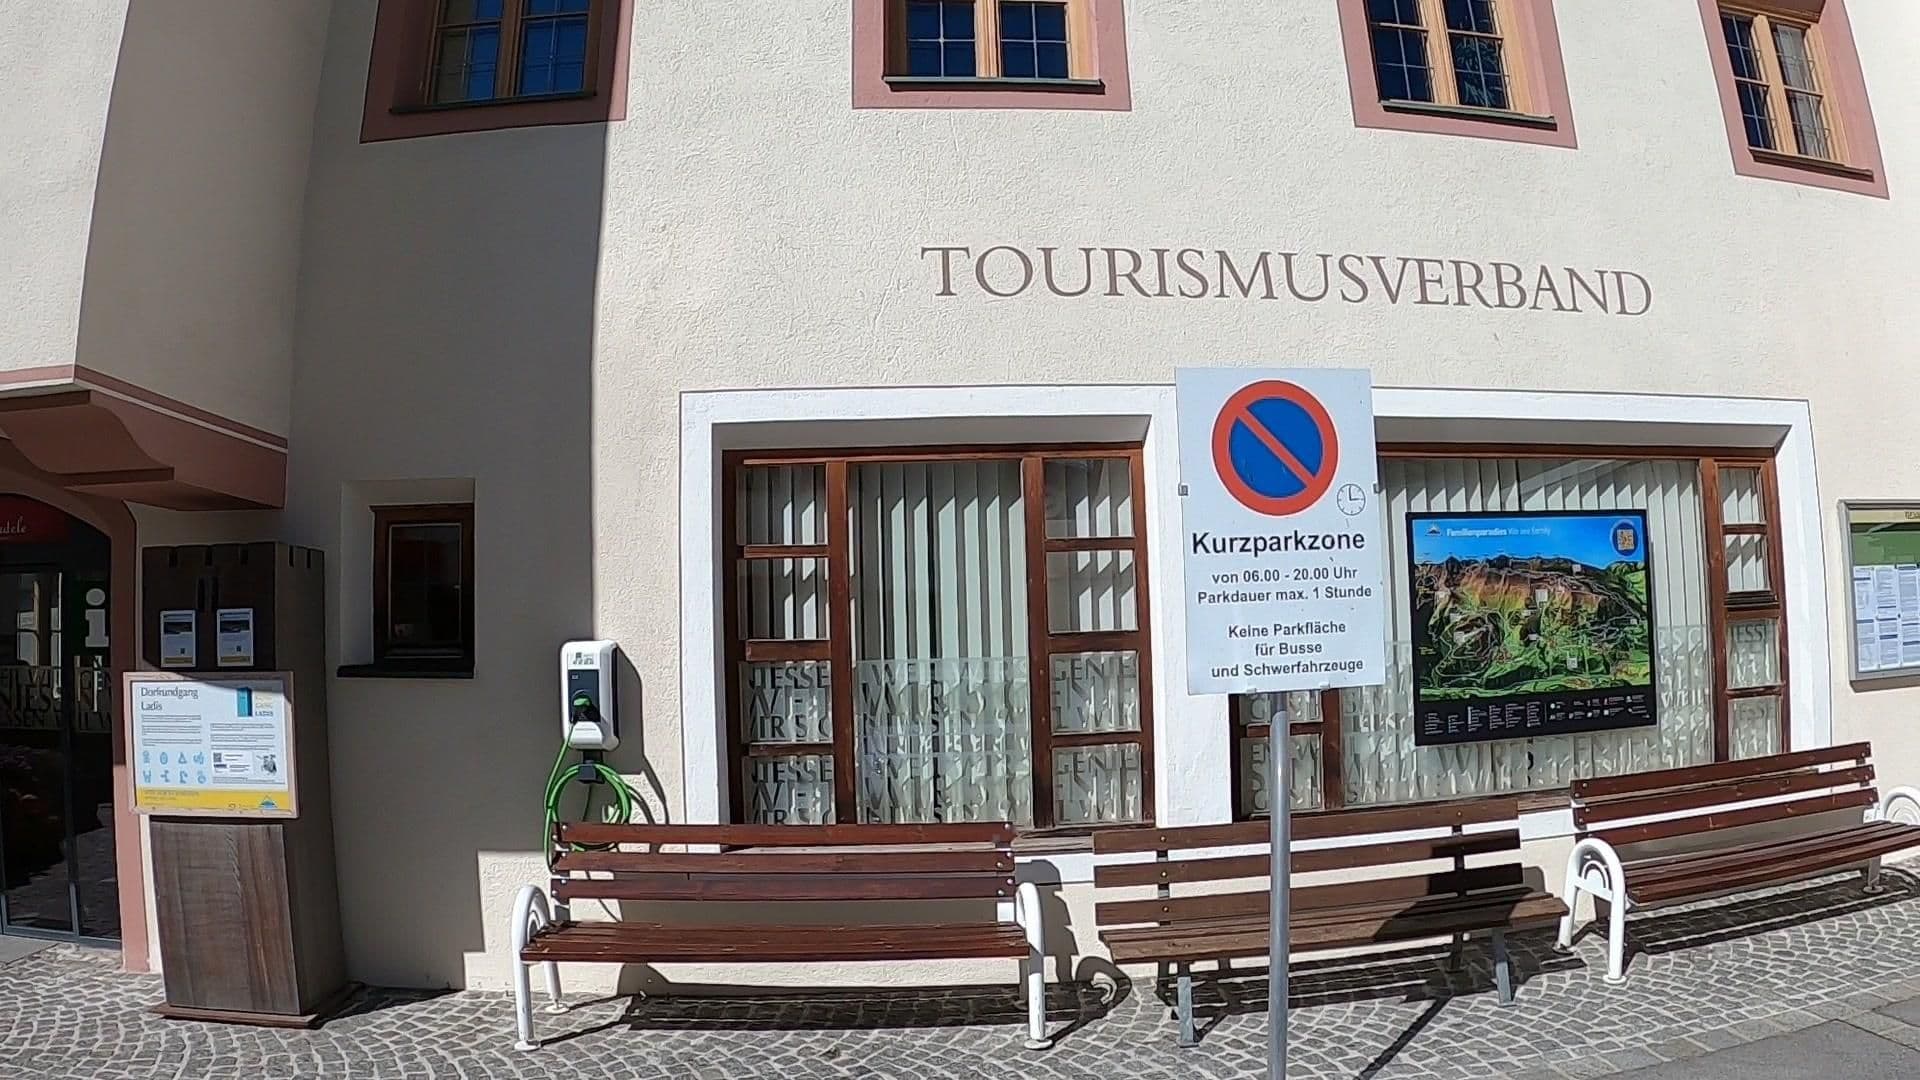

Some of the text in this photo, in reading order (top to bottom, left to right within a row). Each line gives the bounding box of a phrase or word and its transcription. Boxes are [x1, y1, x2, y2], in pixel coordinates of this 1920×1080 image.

[921, 246, 1652, 316] TOURISMUSVERBAND
[1192, 530, 1366, 557] Kurzparkzone
[1211, 574, 1239, 584] von
[1243, 569, 1280, 583] 06.00
[1293, 567, 1329, 581] 20.00
[1333, 566, 1358, 579] Uhr
[1198, 585, 1372, 604] Parkdauer max. 1 Stunde
[1228, 621, 1346, 638] Keine Parkfläche
[1255, 642, 1323, 656] für Busse
[1211, 659, 1364, 678] und Schwerfahrzeuge
[140, 686, 199, 700] Dorfrundgang
[140, 701, 163, 711] Ladis
